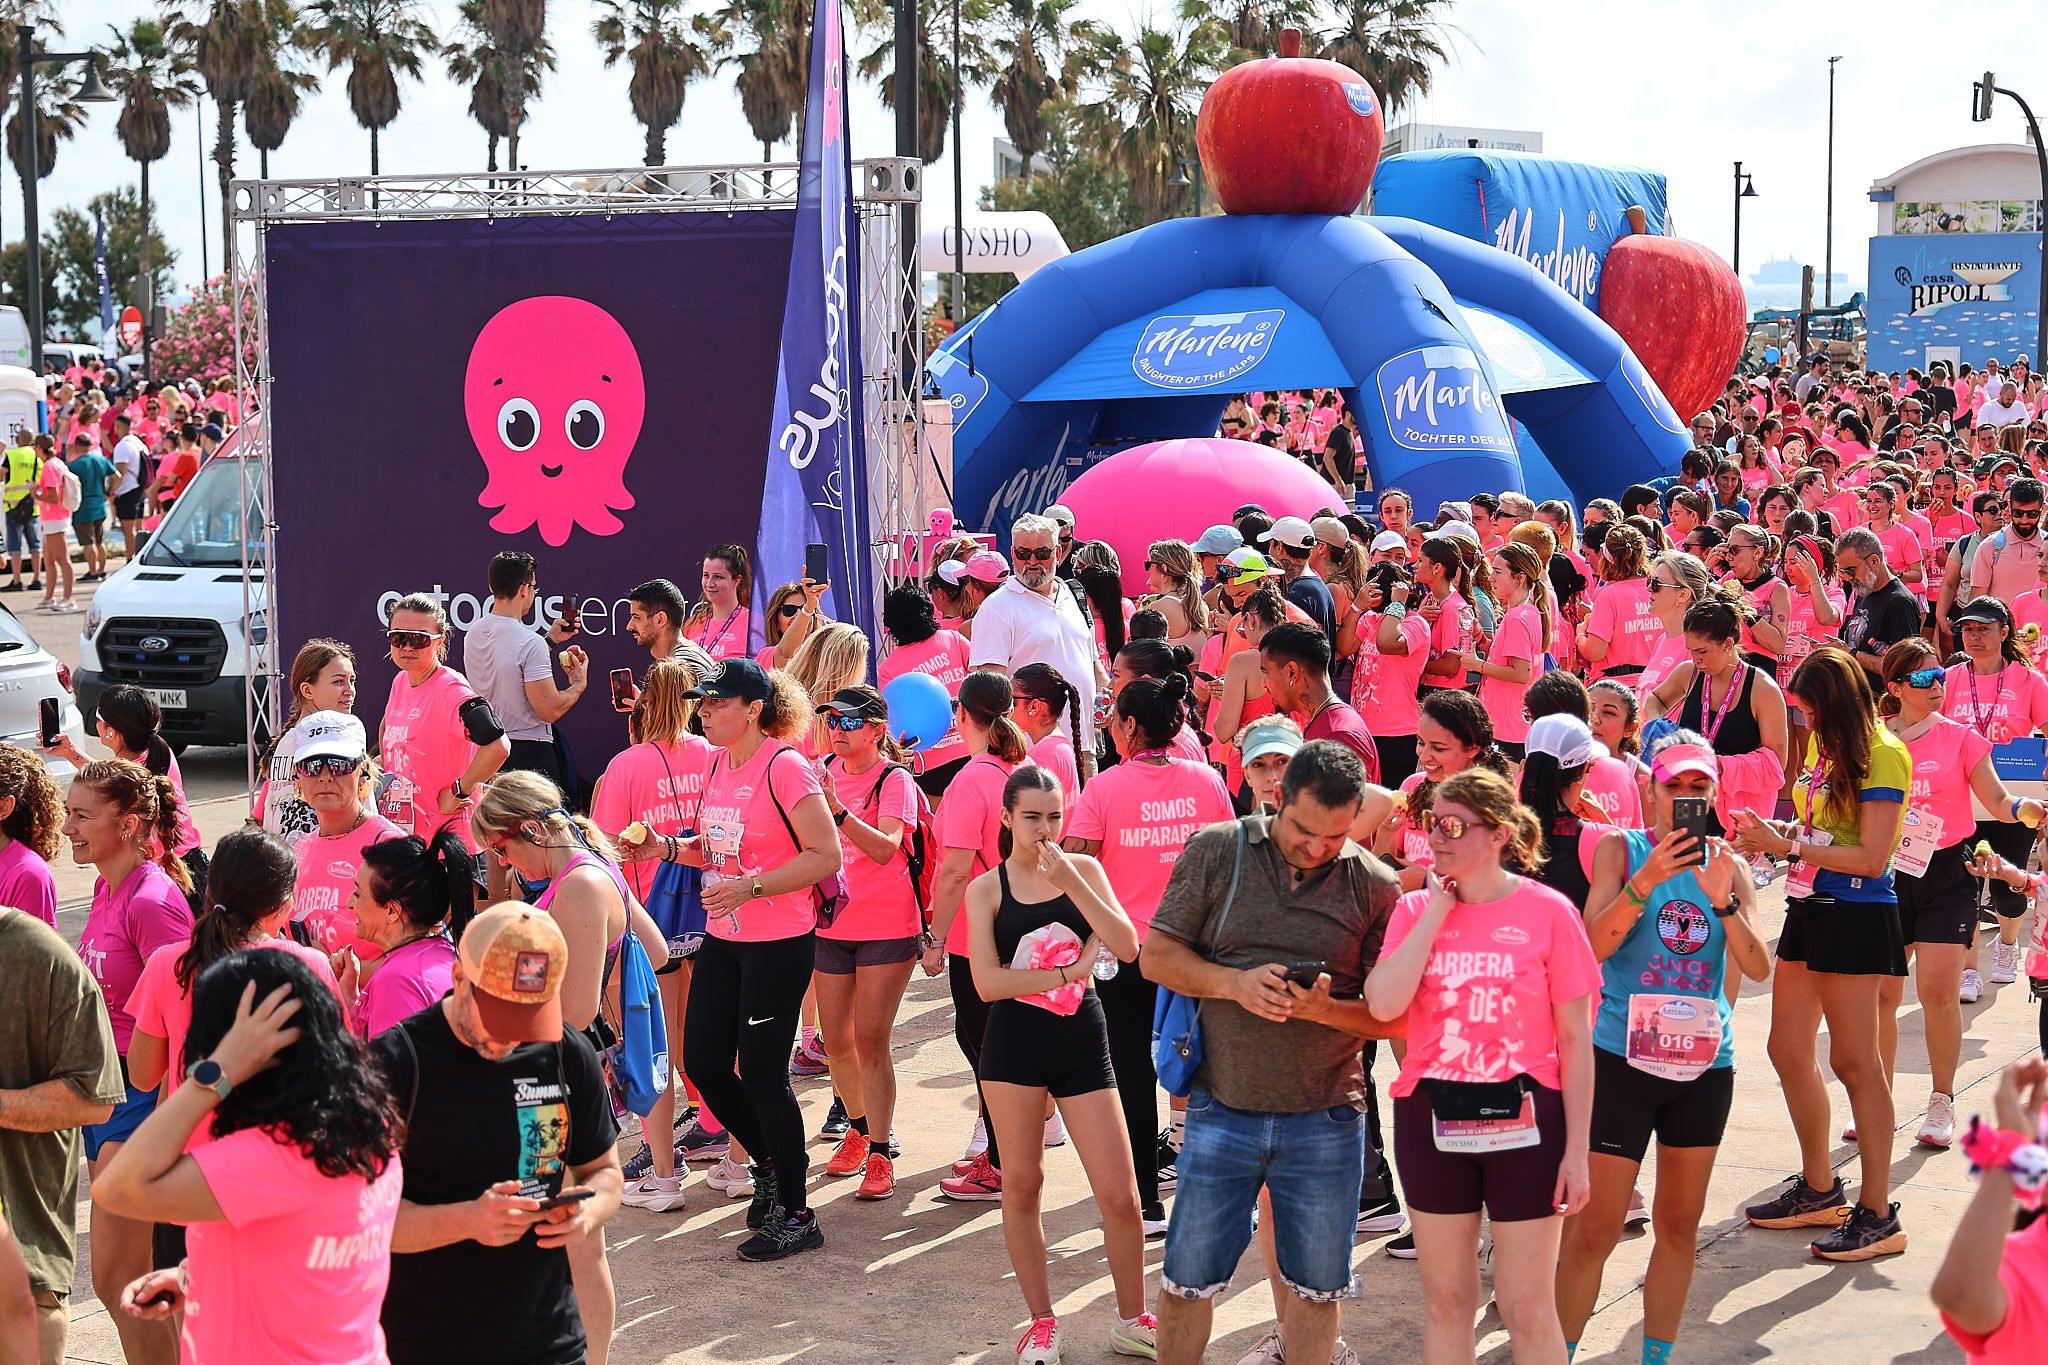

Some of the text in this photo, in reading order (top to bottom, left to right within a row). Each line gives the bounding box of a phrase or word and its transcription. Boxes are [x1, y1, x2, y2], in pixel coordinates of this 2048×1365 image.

[943, 226, 1031, 258] OYSHO
[1951, 262, 2022, 271] RESTAURANTE
[1923, 274, 1954, 284] casa
[1909, 284, 1990, 317] RIPOLL
[1145, 325, 1266, 367] Marlene
[1139, 354, 1257, 385] DAUGHTER OF THE ALPS
[1402, 427, 1467, 445] TOCHTER
[1470, 434, 1496, 446] DER
[1140, 796, 1197, 823] SOMOS
[712, 851, 726, 865] 016
[1659, 1034, 1695, 1050] 016
[1446, 1139, 1478, 1148] OYSHO
[1498, 1135, 1528, 1145] Santander
